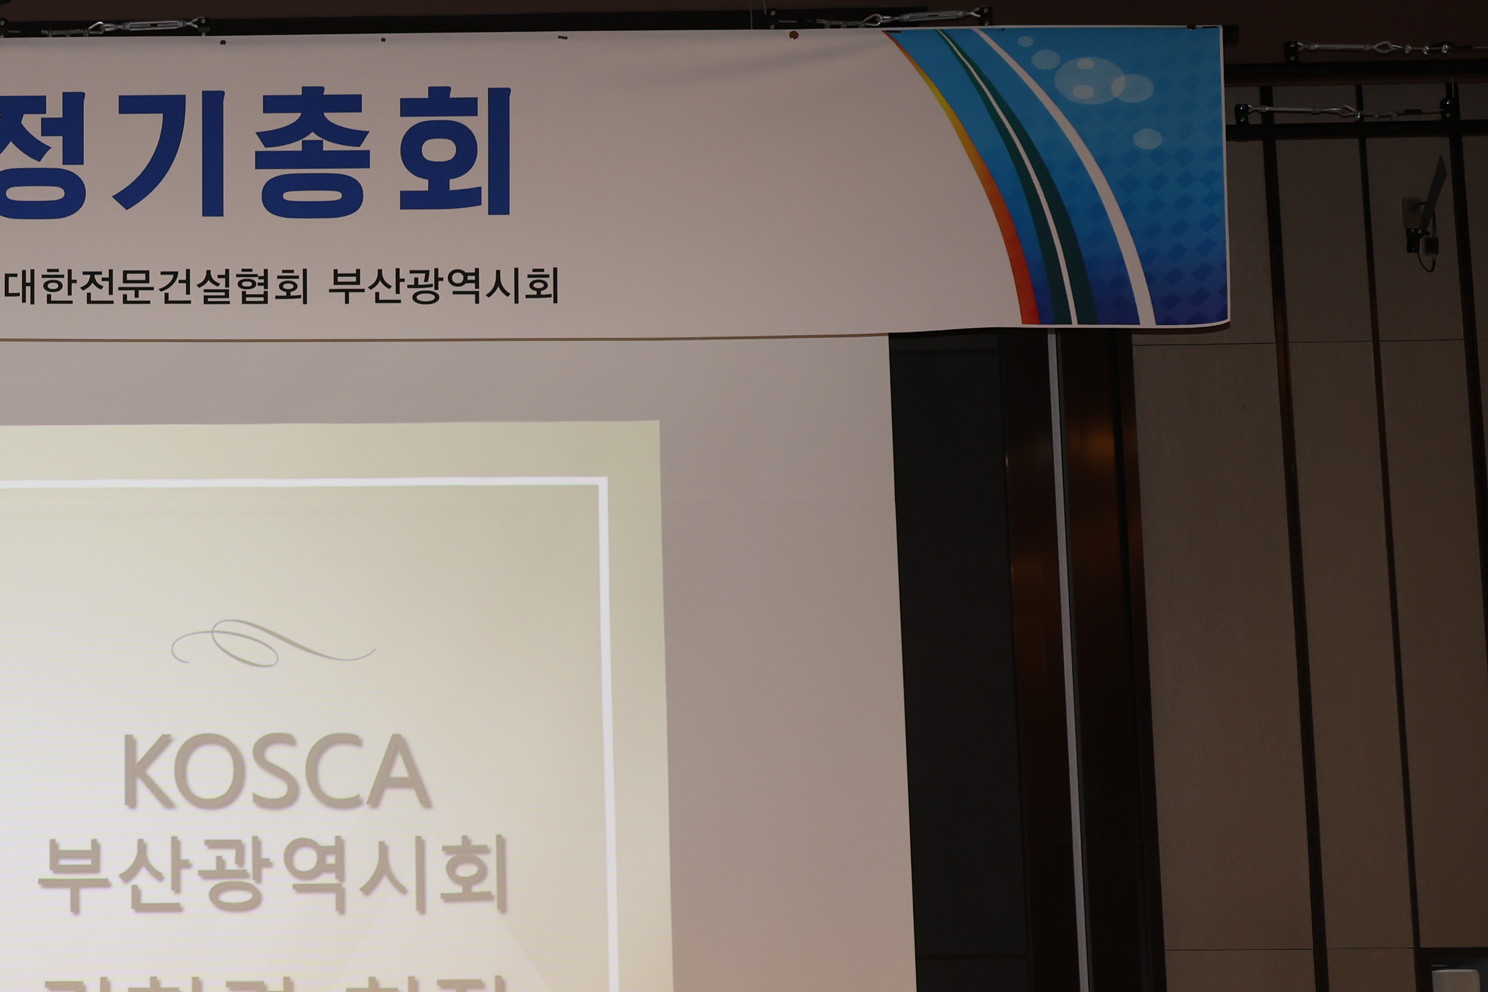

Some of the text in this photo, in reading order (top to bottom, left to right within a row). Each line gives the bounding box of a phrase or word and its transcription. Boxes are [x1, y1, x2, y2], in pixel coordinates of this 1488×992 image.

[3, 267, 308, 306] 대한전문건설협회
[328, 266, 559, 306] 부산광역시회
[123, 732, 433, 811] KOSCA
[37, 833, 509, 916] 부산광역시회
